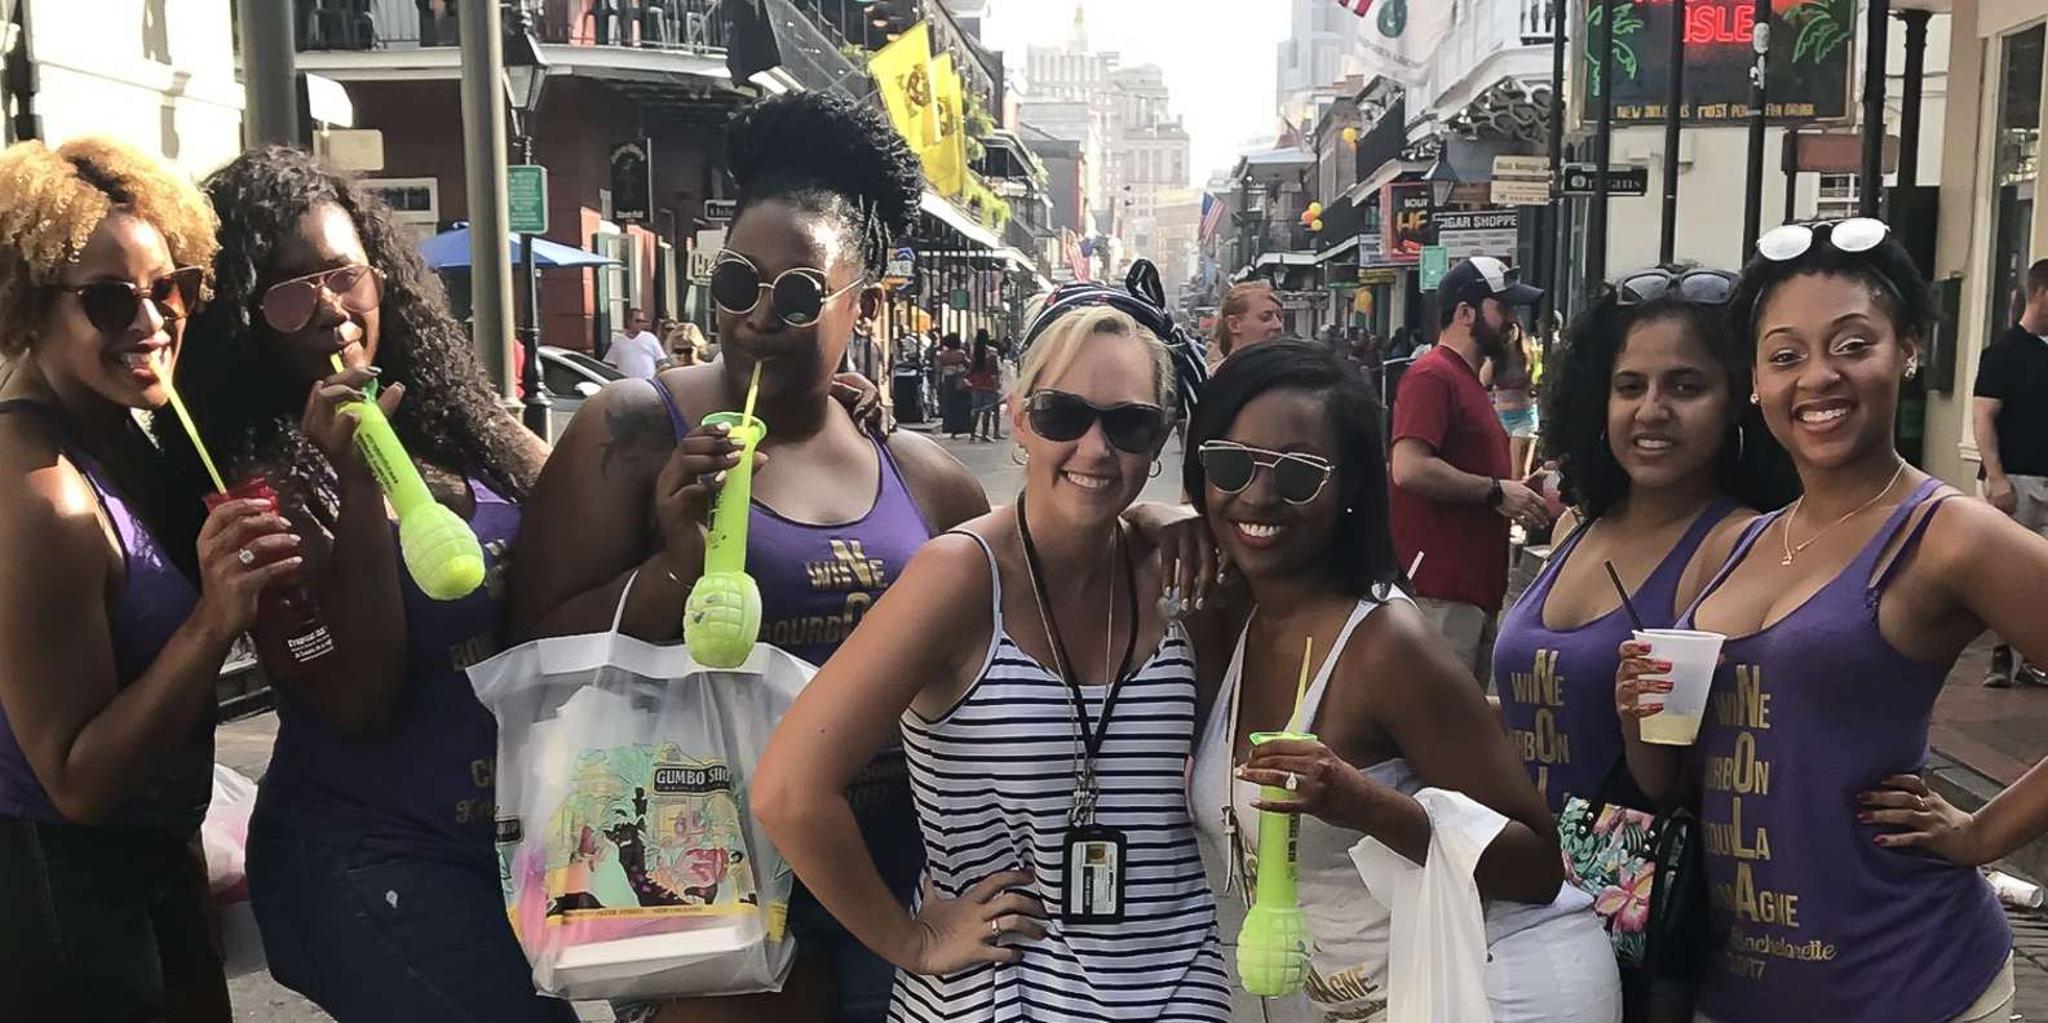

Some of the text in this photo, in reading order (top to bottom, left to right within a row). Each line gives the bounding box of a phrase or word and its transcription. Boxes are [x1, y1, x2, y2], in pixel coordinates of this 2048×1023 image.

[1684, 5, 1755, 43] ISLE
[1570, 175, 1641, 191] Orans
[1473, 213, 1518, 228] SHOPPE
[1511, 649, 1566, 706] WINE
[656, 769, 705, 785] GUMBO
